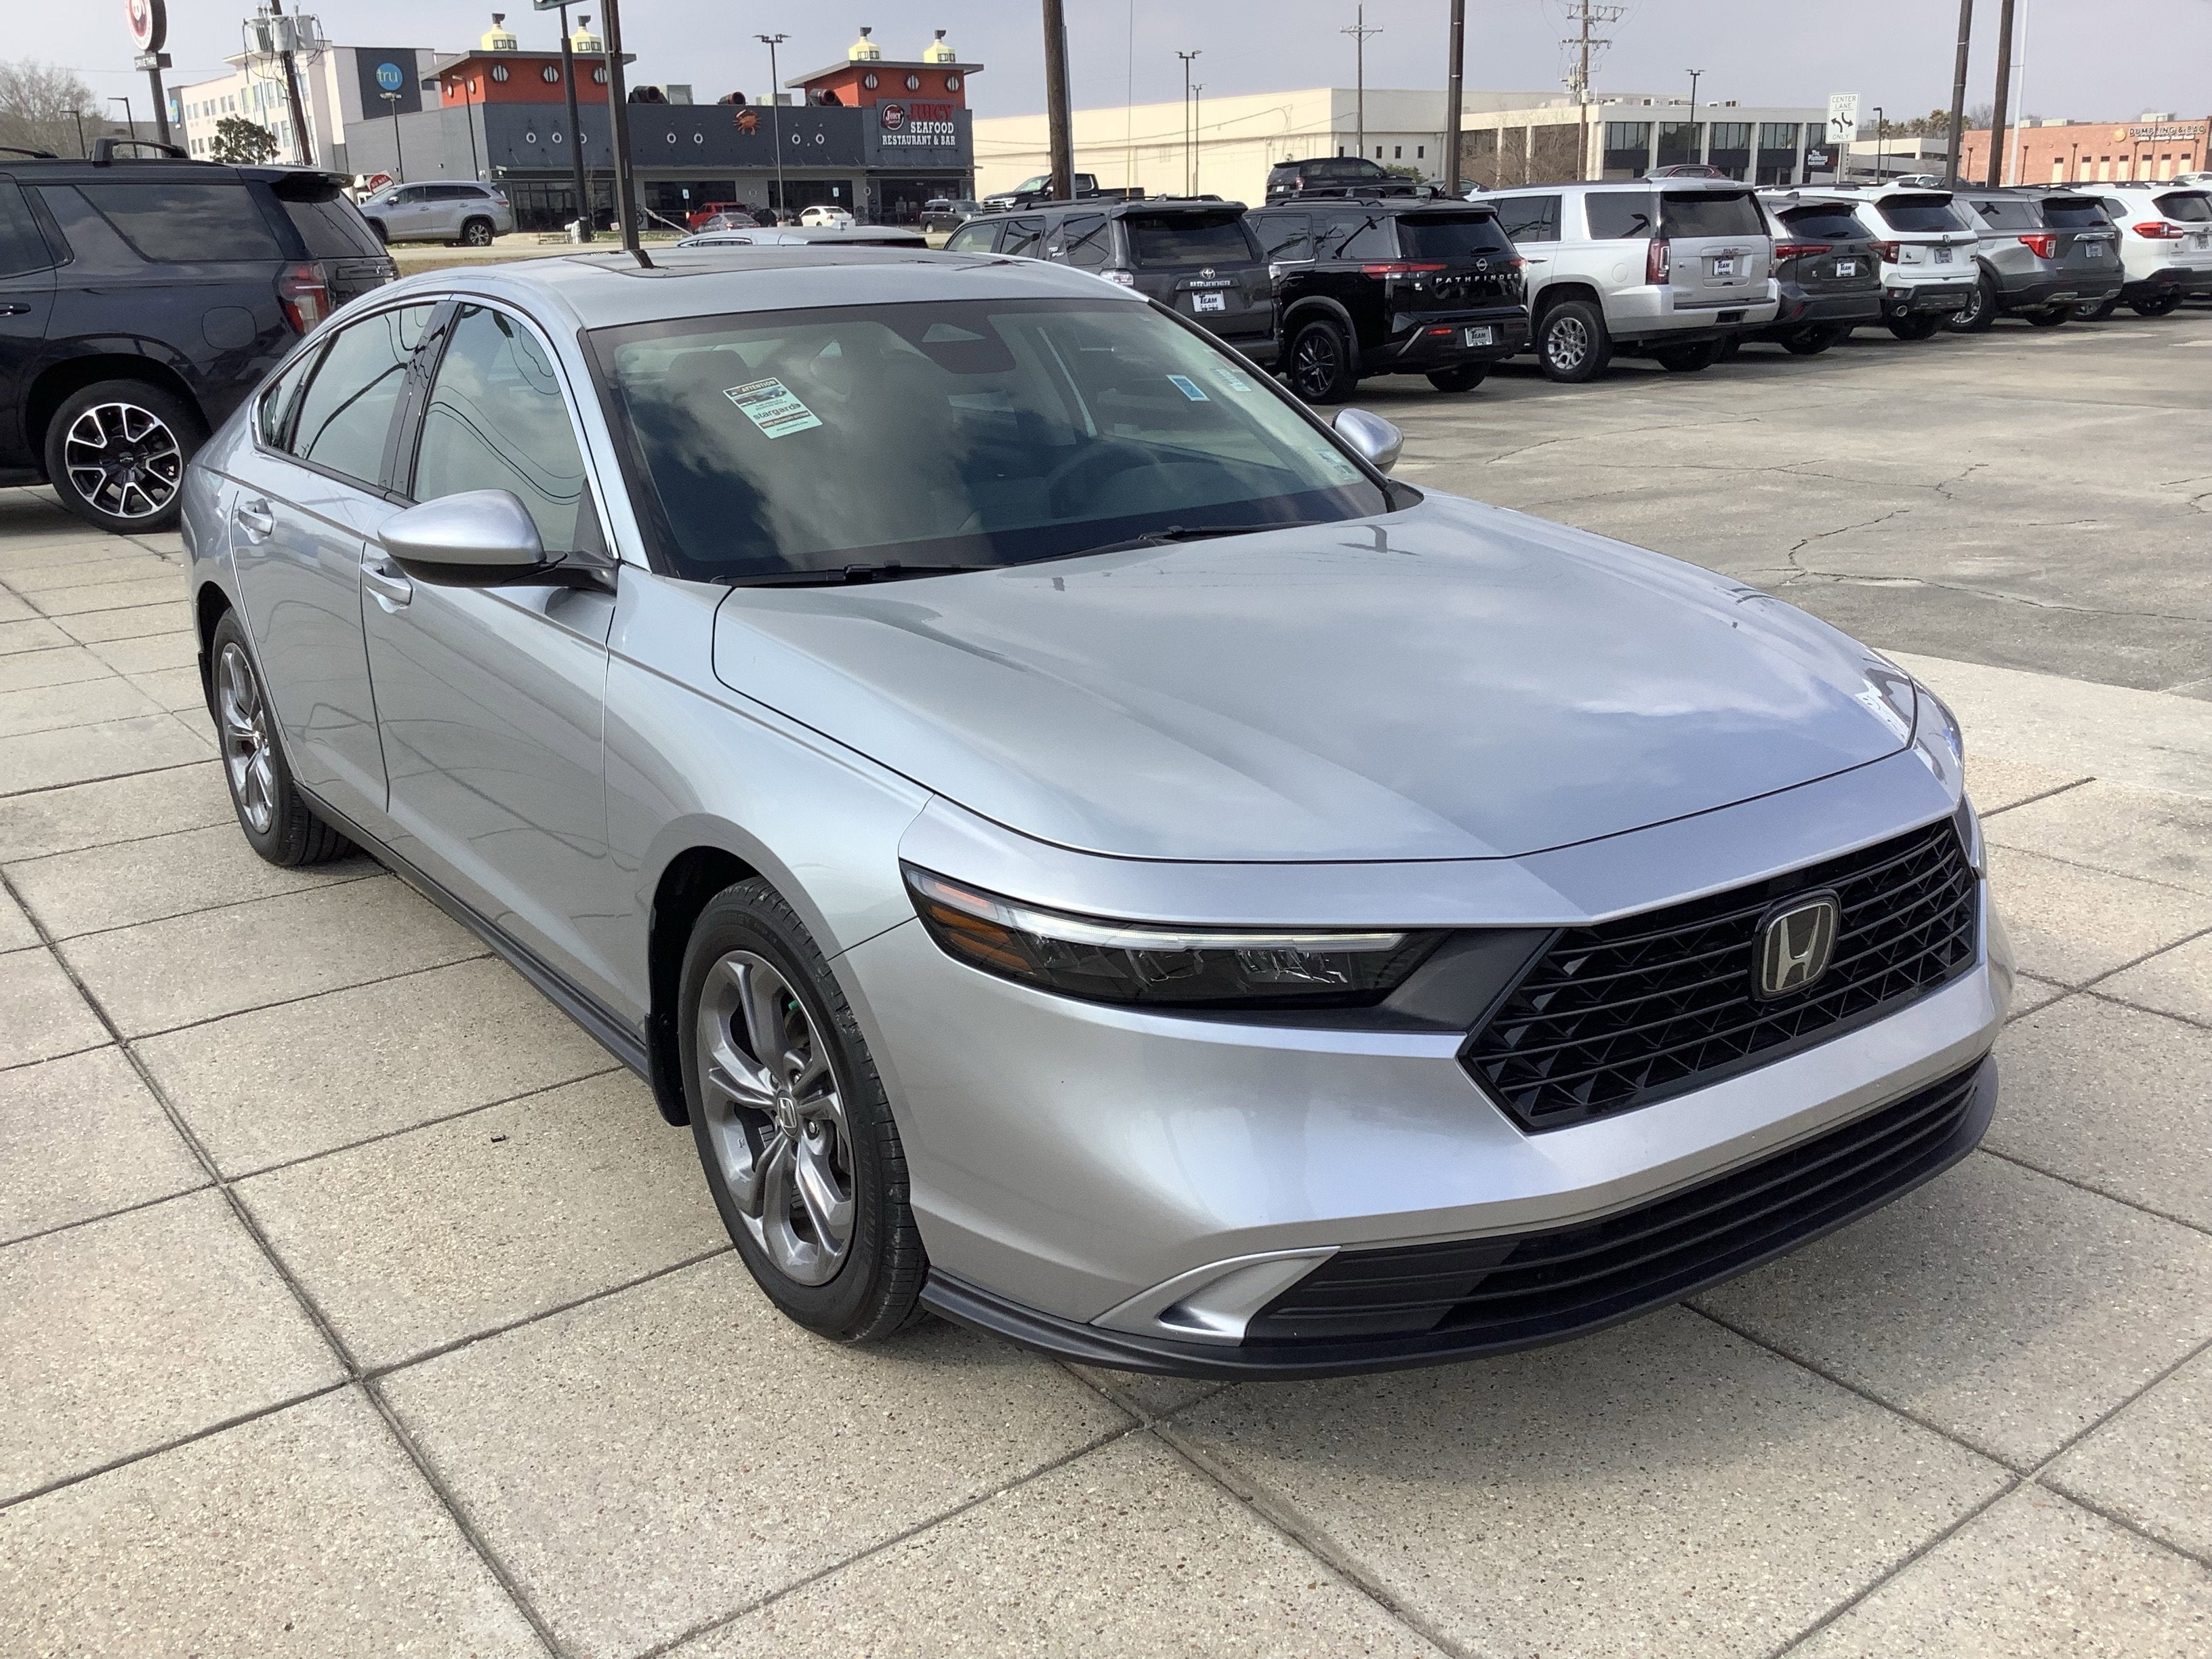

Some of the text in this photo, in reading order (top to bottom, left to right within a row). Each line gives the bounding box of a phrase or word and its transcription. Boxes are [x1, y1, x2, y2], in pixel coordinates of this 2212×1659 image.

[377, 68, 398, 83] tru
[908, 103, 954, 121] JUICY
[910, 122, 954, 134] SEAFOOD
[2129, 127, 2176, 137] DUMPLING
[2187, 125, 2205, 134] BAO
[882, 135, 956, 146] RESTAURANT & BAR
[1718, 260, 1730, 268] TEAM
[1436, 273, 1519, 284] PATHFINDER
[1199, 295, 1217, 304] TEAM
[1471, 331, 1486, 340] TEAM
[741, 380, 777, 392] ATTENTION
[753, 403, 796, 419] stargard
